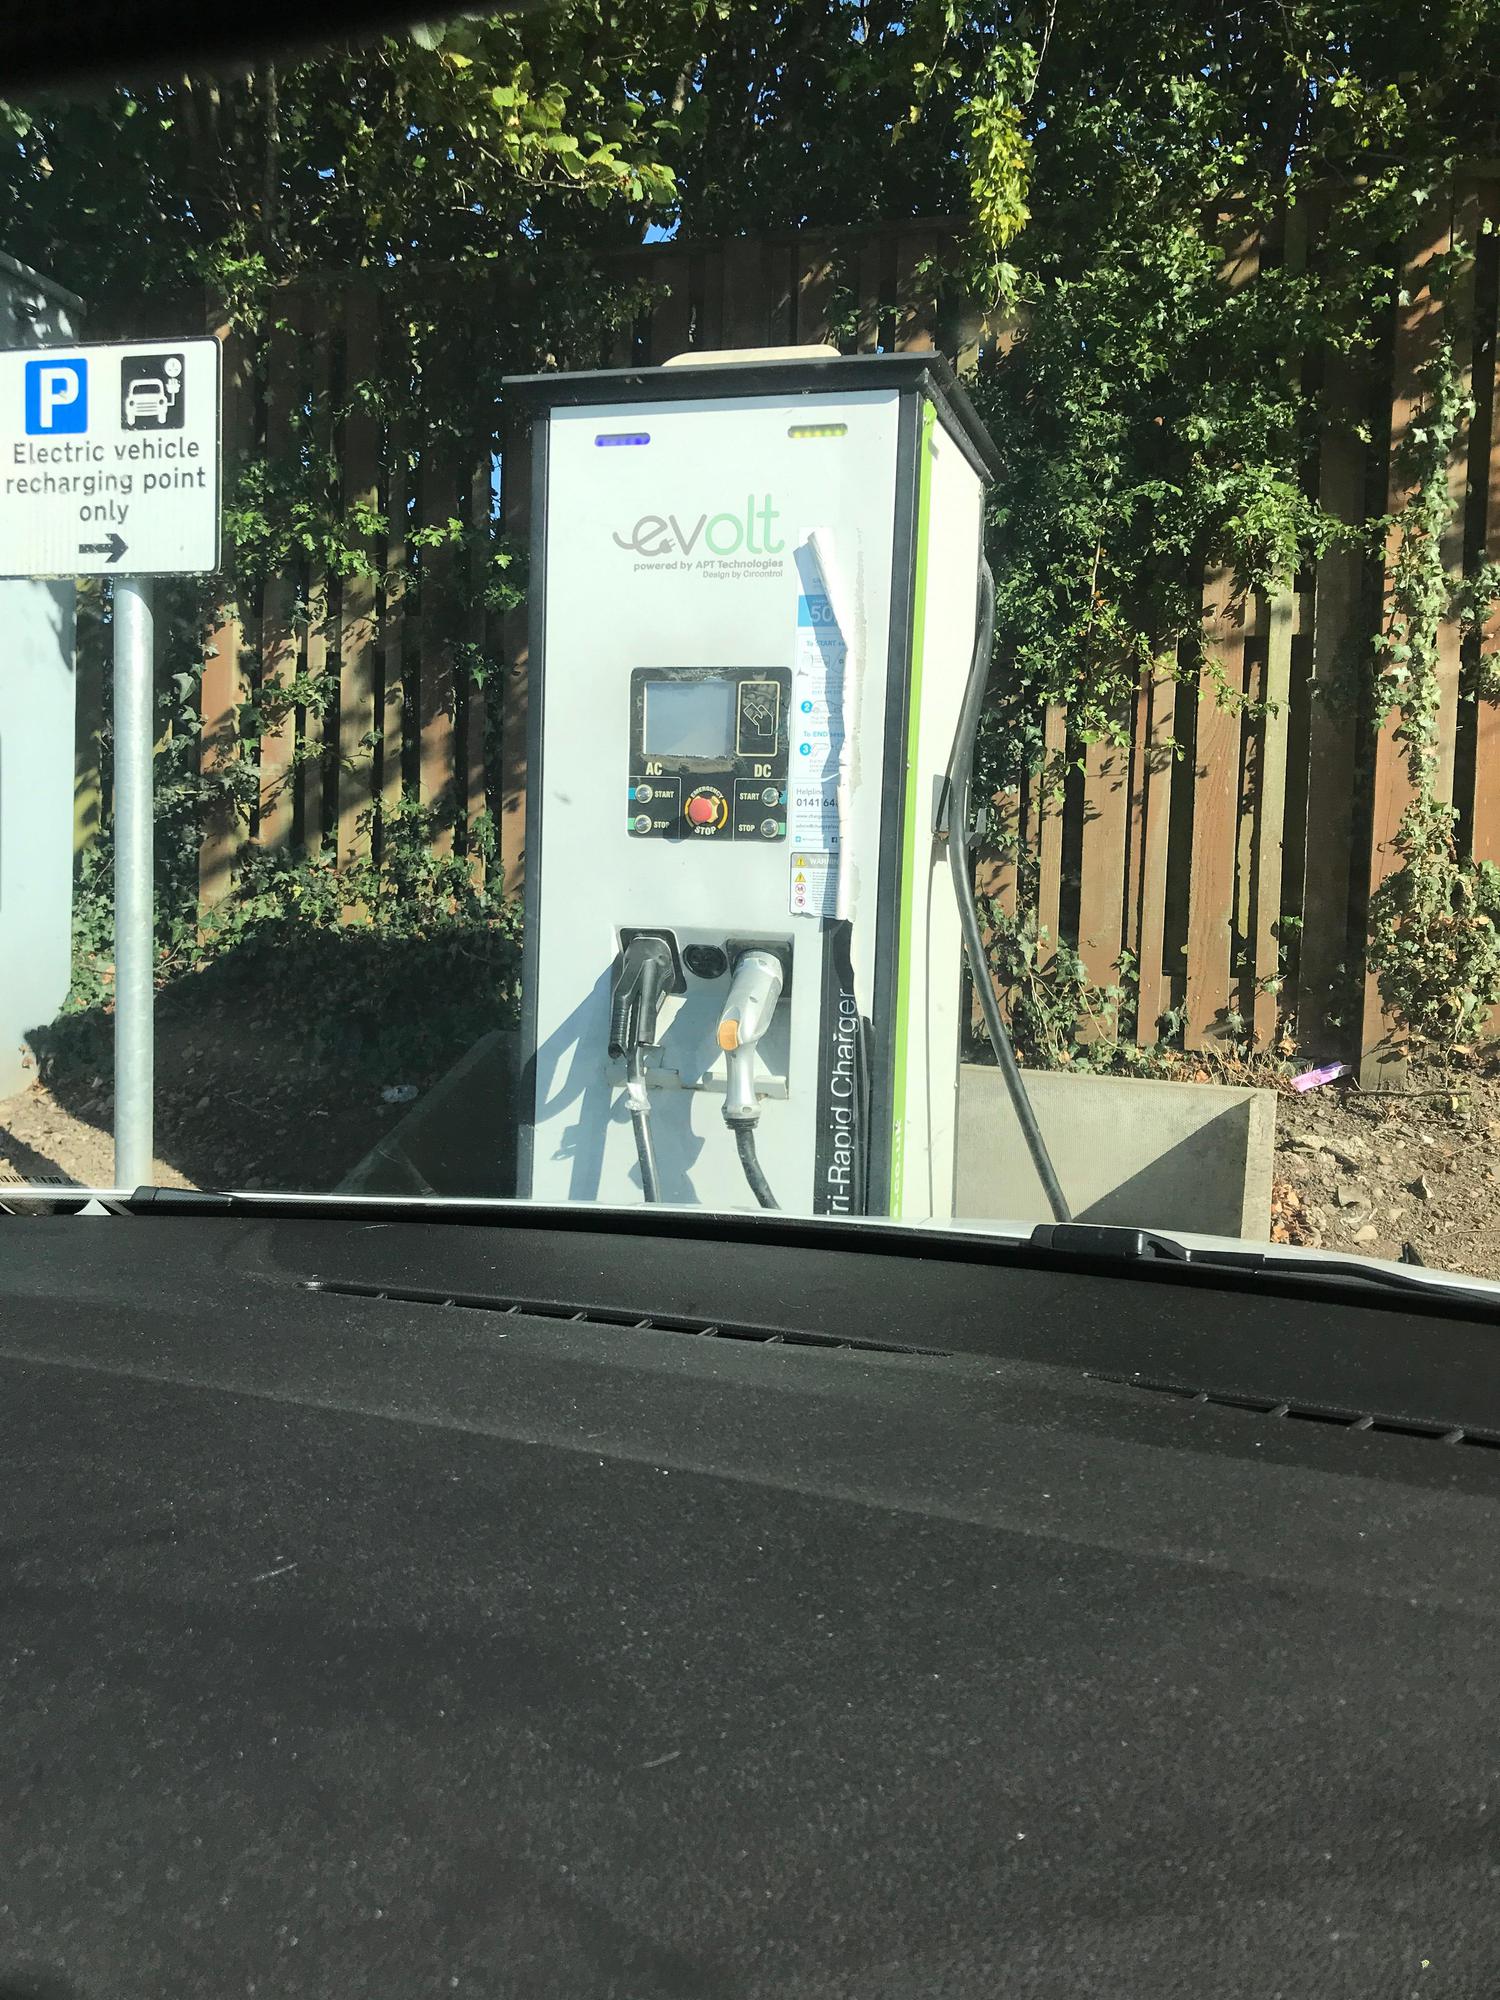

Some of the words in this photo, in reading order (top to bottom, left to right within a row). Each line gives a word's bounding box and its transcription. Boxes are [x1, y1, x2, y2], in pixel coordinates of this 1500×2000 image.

[40, 367, 79, 428] P
[13, 439, 104, 464] Electric
[114, 437, 200, 460] vehicle
[6, 470, 133, 496] recharging
[143, 467, 206, 492] point
[79, 499, 129, 525] only
[612, 494, 785, 557] evolt
[634, 561, 678, 572] powered
[680, 560, 693, 571] by
[695, 560, 716, 569] APT
[718, 558, 784, 570] Technologies
[702, 570, 730, 580] Design
[732, 569, 741, 579] by
[743, 569, 784, 578] Circontrol
[810, 606, 833, 623] 50
[645, 762, 662, 776] AC
[754, 764, 772, 778] DC
[654, 790, 674, 798] START
[690, 786, 724, 799] EMERGENCY
[739, 792, 759, 801] START
[796, 798, 820, 807] 0141
[653, 821, 670, 829] STOP
[694, 825, 717, 835] STOP
[738, 824, 755, 832] STOP
[831, 988, 860, 1098] Charger
[827, 1107, 855, 1216] ri-Rapid
